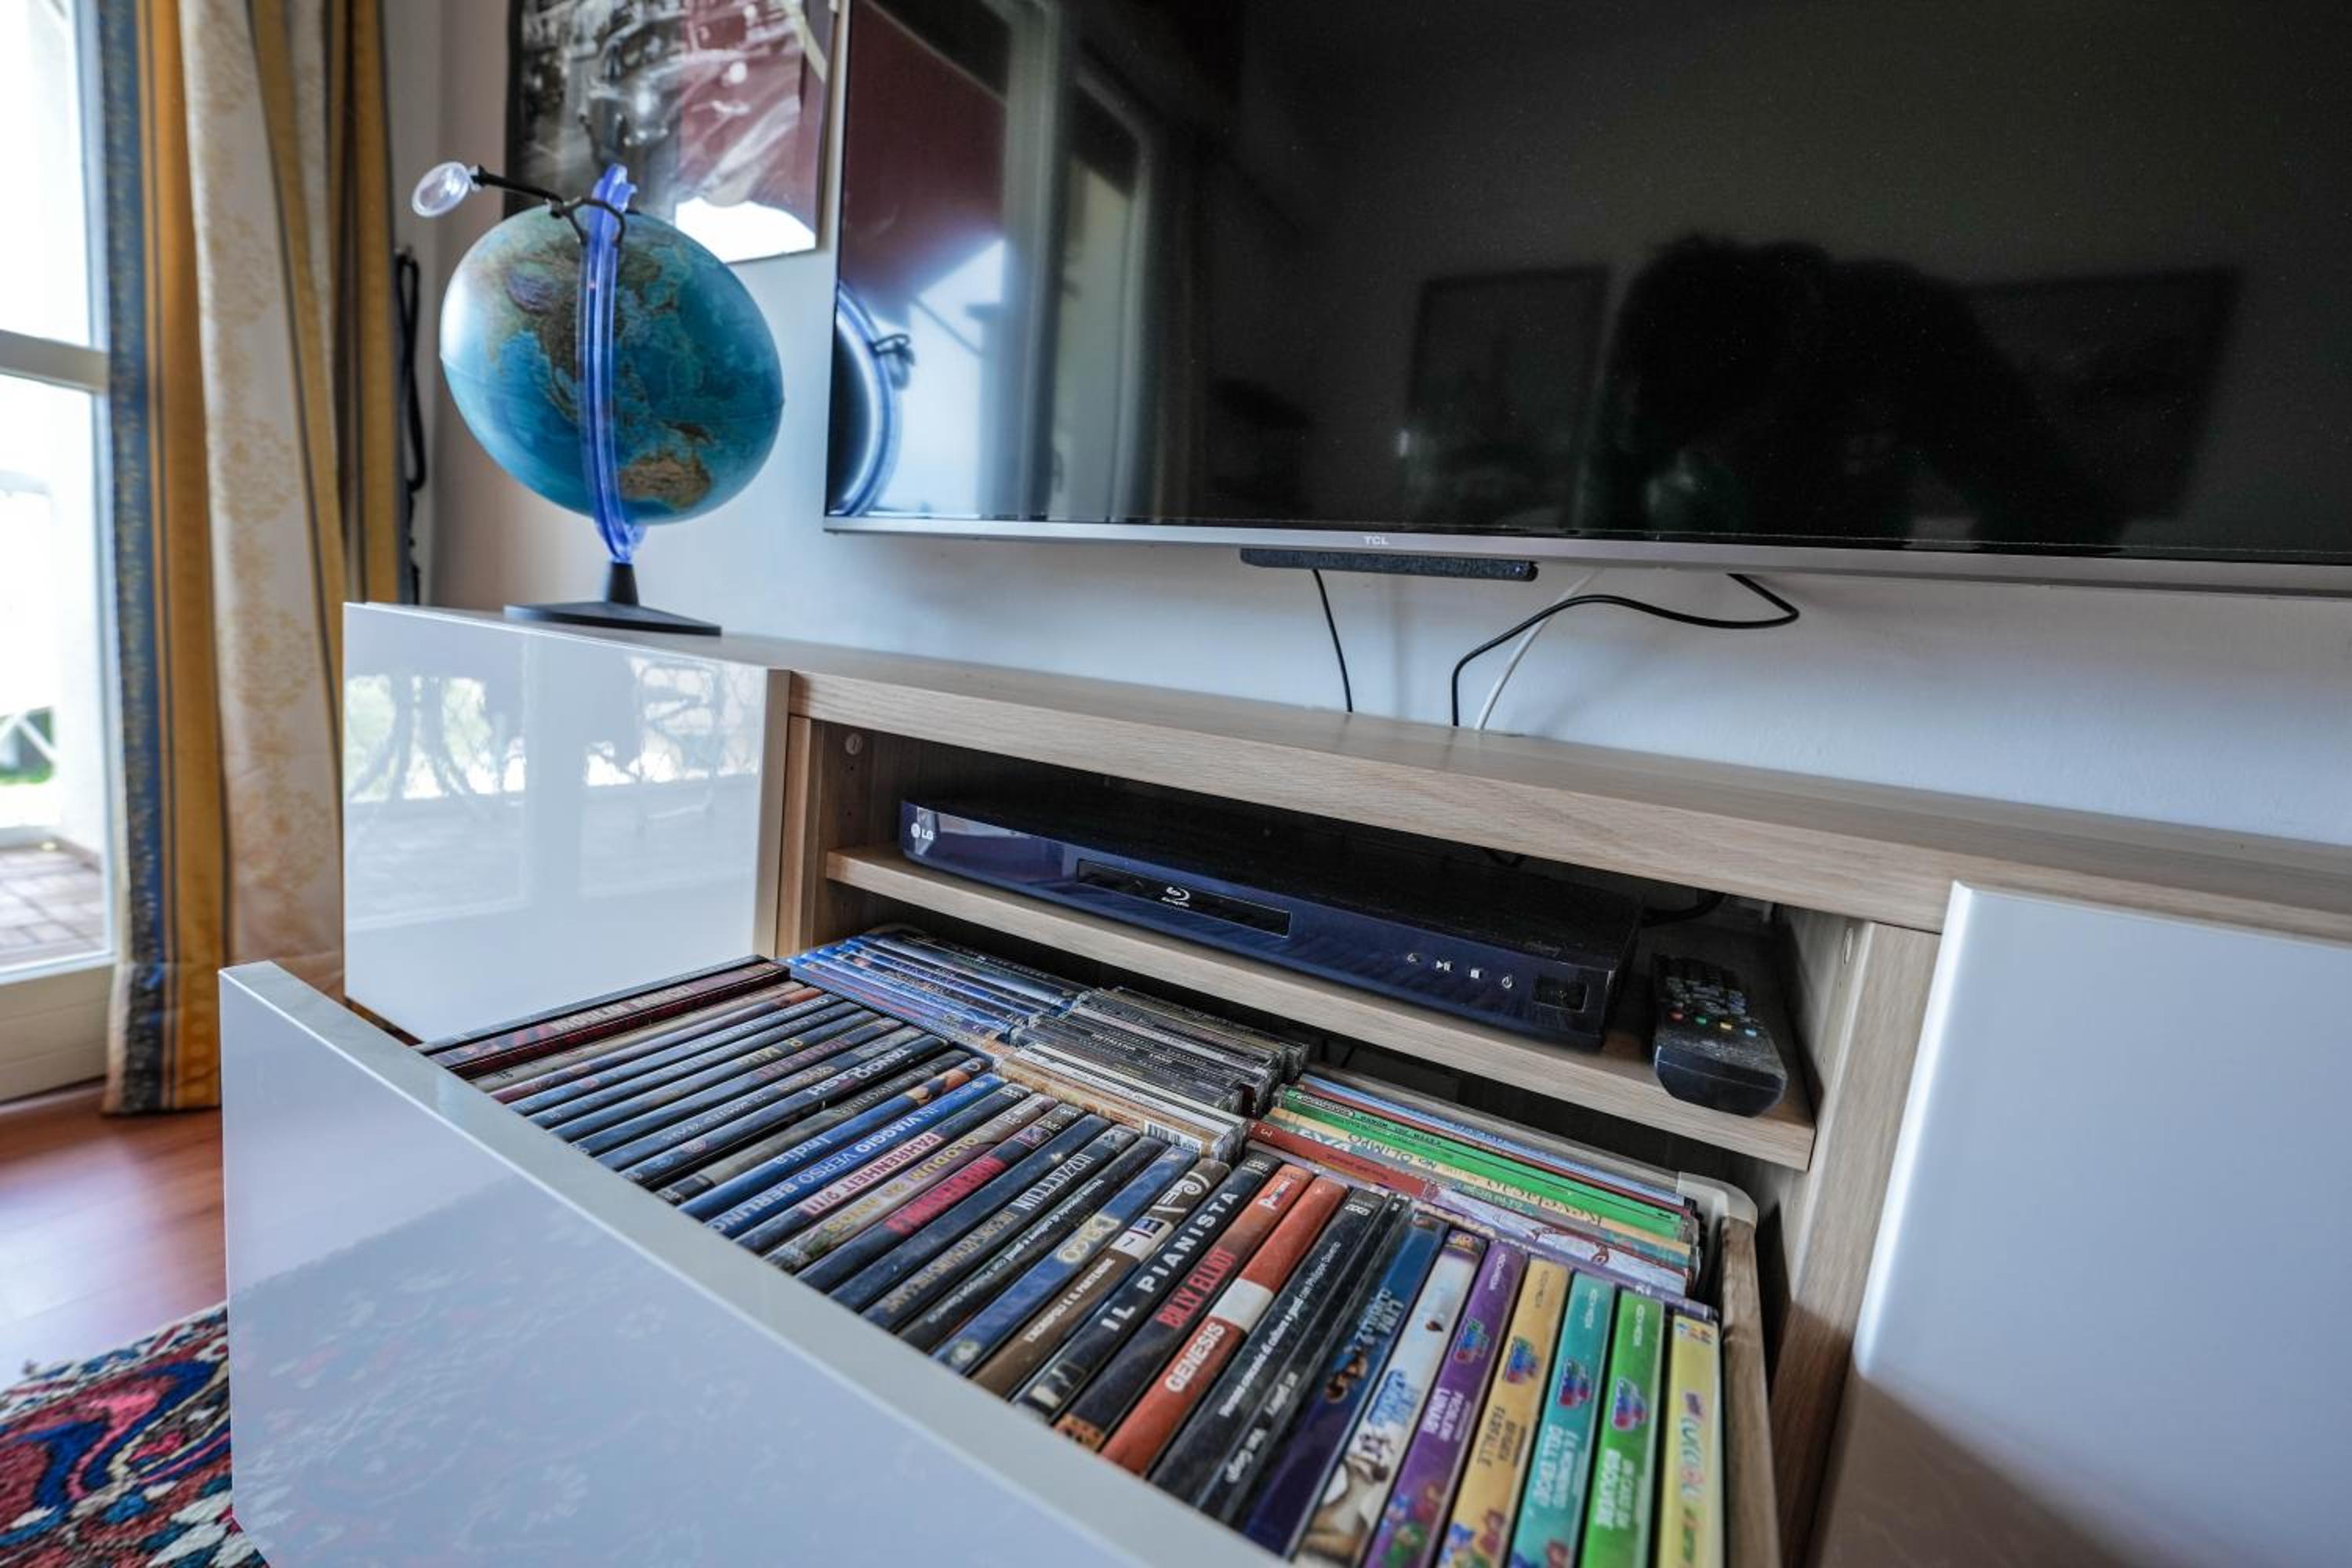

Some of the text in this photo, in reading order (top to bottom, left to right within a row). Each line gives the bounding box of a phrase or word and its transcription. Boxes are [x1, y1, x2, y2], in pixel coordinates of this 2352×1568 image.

[1363, 535, 1389, 545] TCL
[848, 1046, 916, 1079] TANGO
[772, 1133, 831, 1169] India
[853, 1112, 922, 1156] VIAGGIO
[1260, 1128, 1273, 1138] 3
[1345, 1131, 1414, 1164] OLIMPO
[797, 1148, 856, 1186] VERSO
[839, 1131, 939, 1196] FAHRENHEIT
[906, 1133, 981, 1184] OLODUM
[801, 1185, 842, 1217] 9/11
[1099, 1189, 1240, 1335] IL PIANISTA
[1156, 1247, 1237, 1330] BILLY ELLIOT
[1163, 1320, 1227, 1393] GENESIS
[1469, 1404, 1516, 1468] FARFALLE
